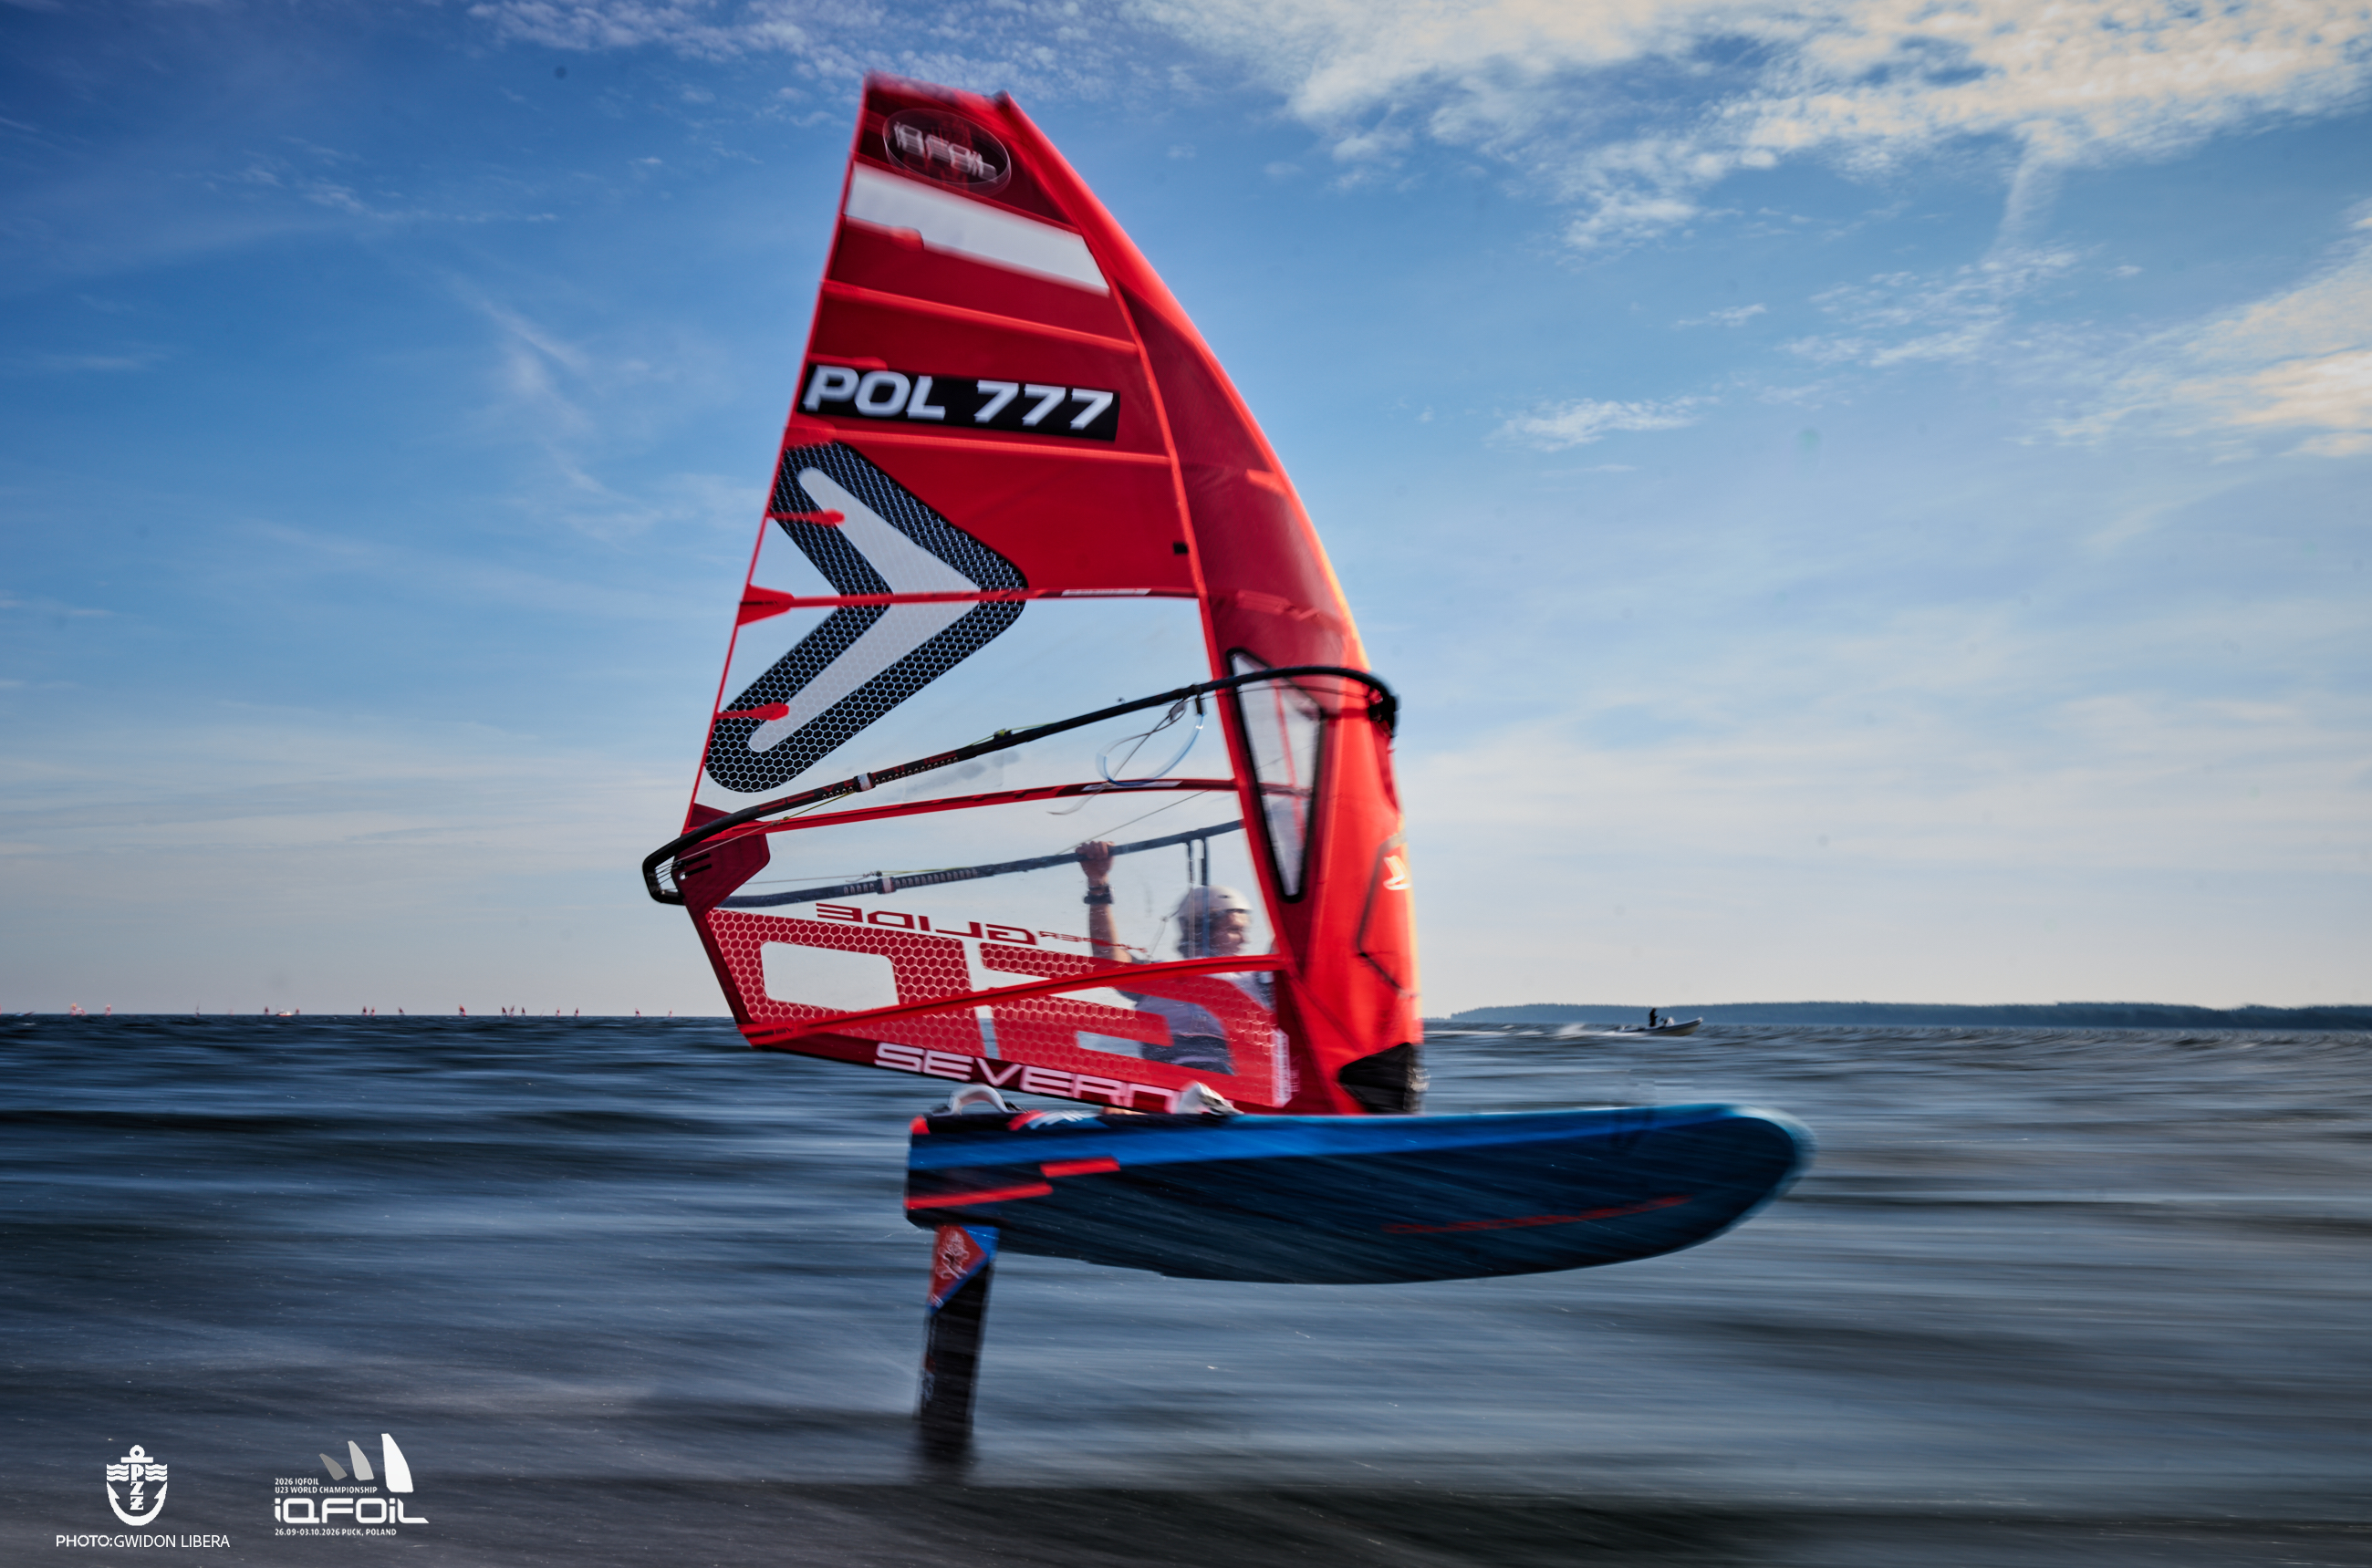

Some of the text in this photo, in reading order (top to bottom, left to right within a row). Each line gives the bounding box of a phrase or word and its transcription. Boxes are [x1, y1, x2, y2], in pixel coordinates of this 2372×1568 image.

[803, 365, 1113, 430] POL 777
[874, 1042, 1233, 1115] SEVERN
